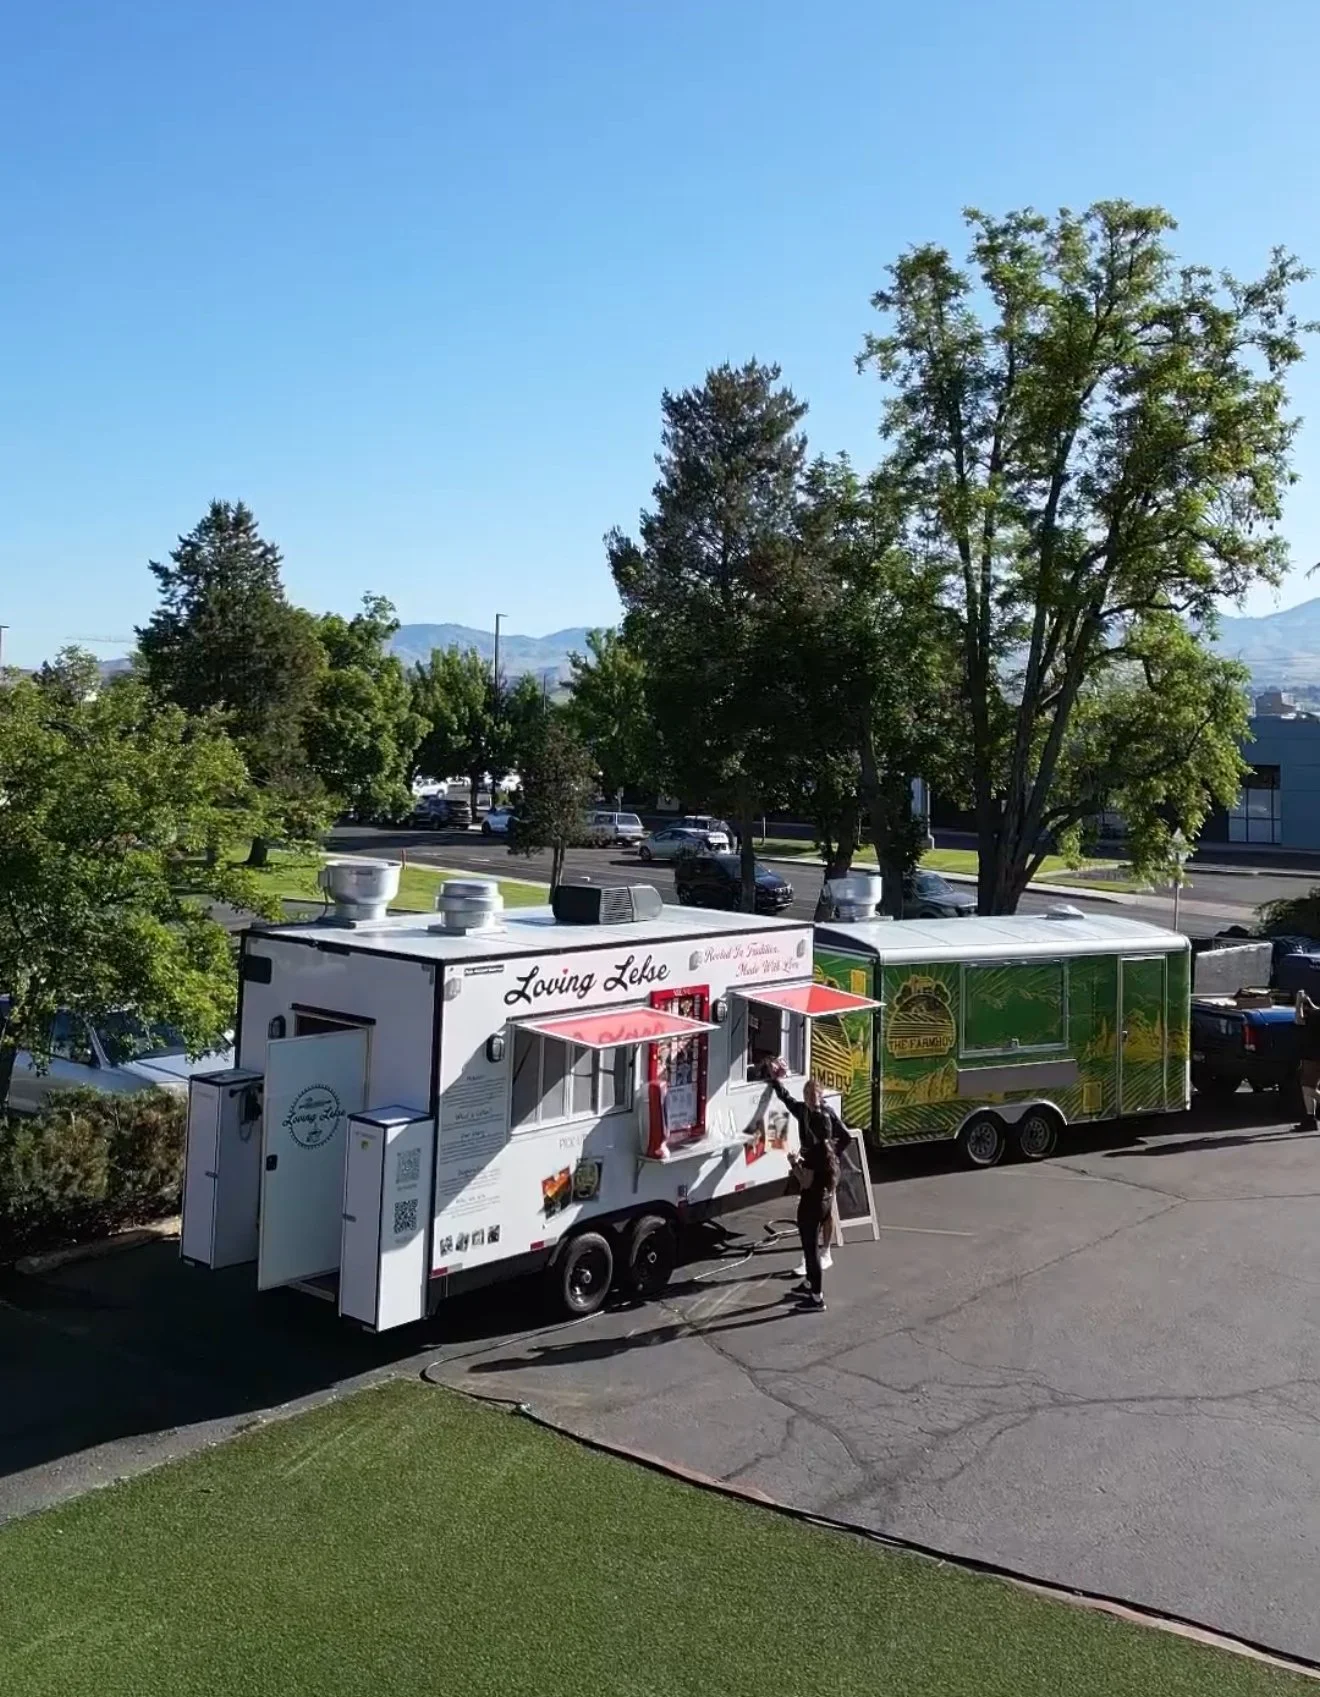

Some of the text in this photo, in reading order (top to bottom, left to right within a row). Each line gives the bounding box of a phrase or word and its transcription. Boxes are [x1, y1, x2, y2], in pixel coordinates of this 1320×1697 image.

[504, 955, 670, 1005] Loving Lefse
[889, 1037, 909, 1051] THE
